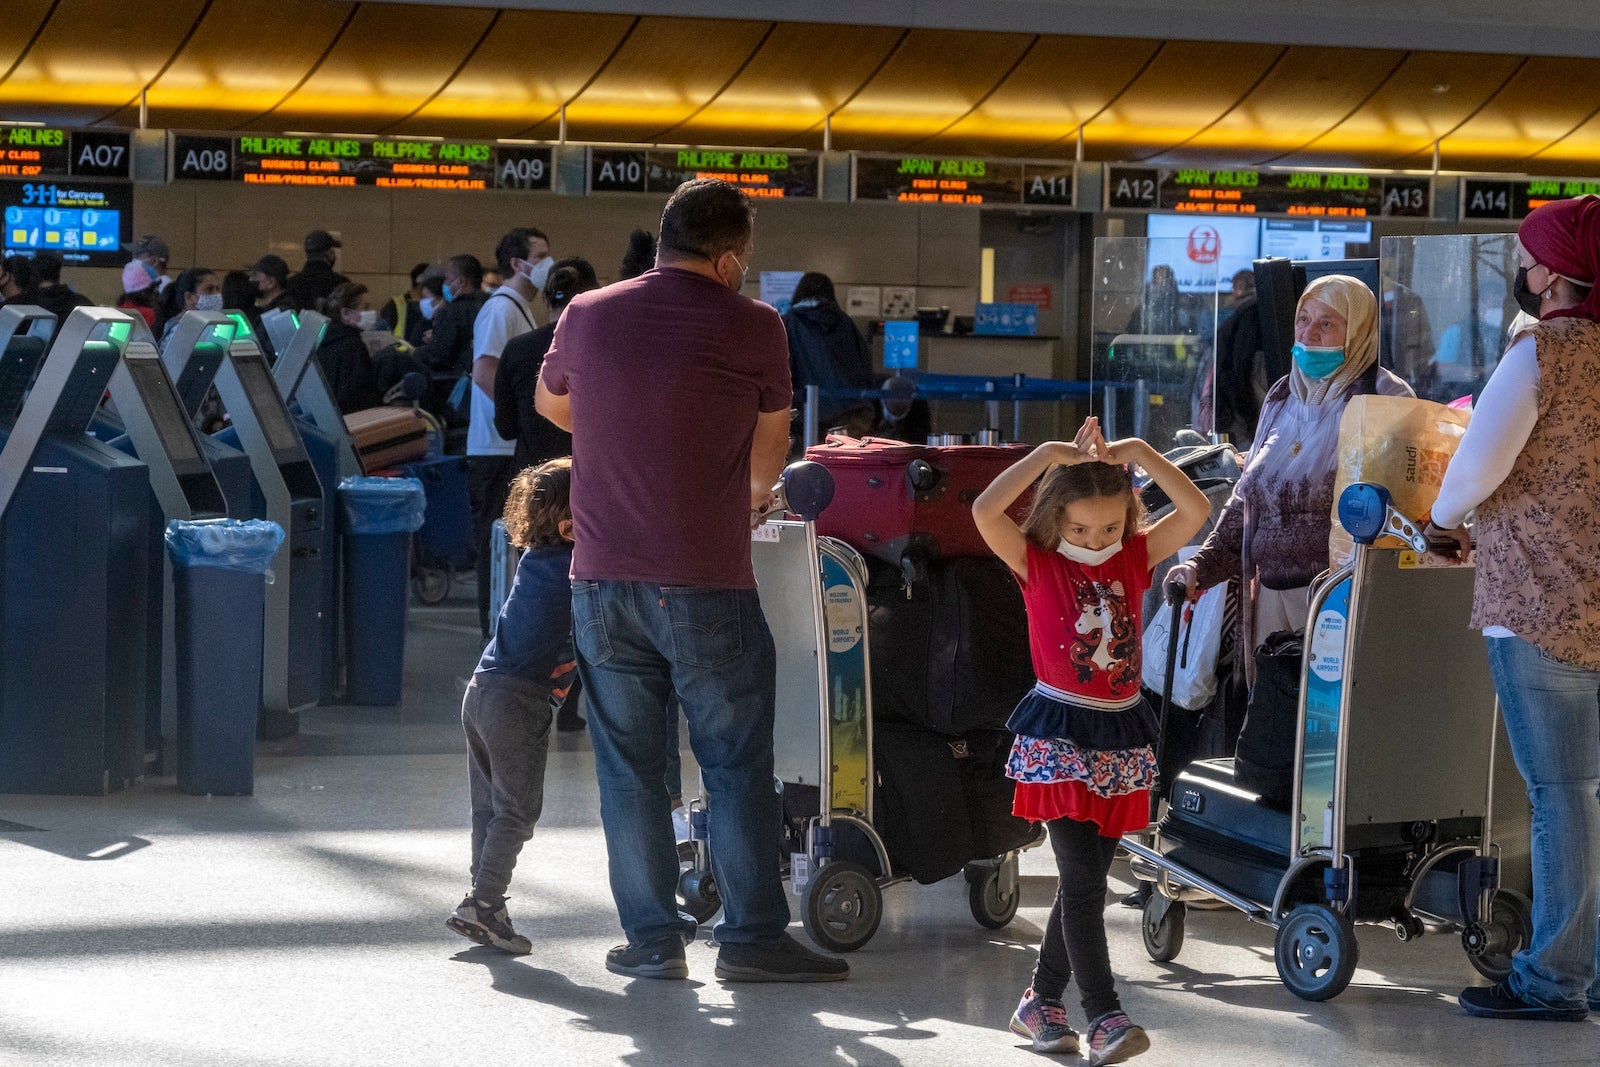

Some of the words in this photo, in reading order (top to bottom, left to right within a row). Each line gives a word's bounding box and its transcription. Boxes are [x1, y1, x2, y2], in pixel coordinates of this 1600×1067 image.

[9, 128, 64, 146] AIRLINES
[8, 150, 41, 161] CLASS
[78, 144, 125, 168] A07
[240, 137, 302, 156] PHILIPPINE
[308, 139, 361, 157] AIRLINES
[373, 141, 433, 159] PHILIPPINE
[439, 144, 491, 161] AIRLINES
[182, 150, 227, 172] A08
[261, 159, 306, 171] BUSINESS
[308, 161, 340, 172] CLASS
[393, 163, 437, 175] BUSINESS
[439, 165, 469, 176] CLASS
[502, 158, 544, 181] A09
[677, 150, 735, 170] PHILIPPINE
[740, 152, 789, 171] AIRLINES
[897, 158, 935, 175] JAPAN
[938, 160, 986, 177] AIRLINES
[22, 165, 42, 176] 207
[598, 160, 641, 183] A10
[740, 174, 769, 185] CLASS
[1174, 169, 1210, 185] JAPAN
[1214, 170, 1259, 187] AIRLINES
[912, 179, 938, 190] FIRST
[939, 180, 967, 191] CLASS
[1030, 175, 1067, 197] A11
[1116, 178, 1155, 200] A12
[1286, 172, 1321, 189] JAPAN
[1325, 174, 1370, 191] AIRLINES
[1526, 180, 1560, 197] JAPAN
[22, 183, 58, 206] 3-1-1
[57, 189, 68, 200] for
[1215, 190, 1241, 200] CLASS
[1387, 187, 1424, 209] A13
[1470, 190, 1507, 210] A14
[1406, 446, 1417, 483] saudi
[832, 629, 849, 637] WORLD
[832, 636, 856, 644] AIRPORTS
[1316, 665, 1339, 673] AIRPORTS
[1322, 656, 1339, 664] WORLD
